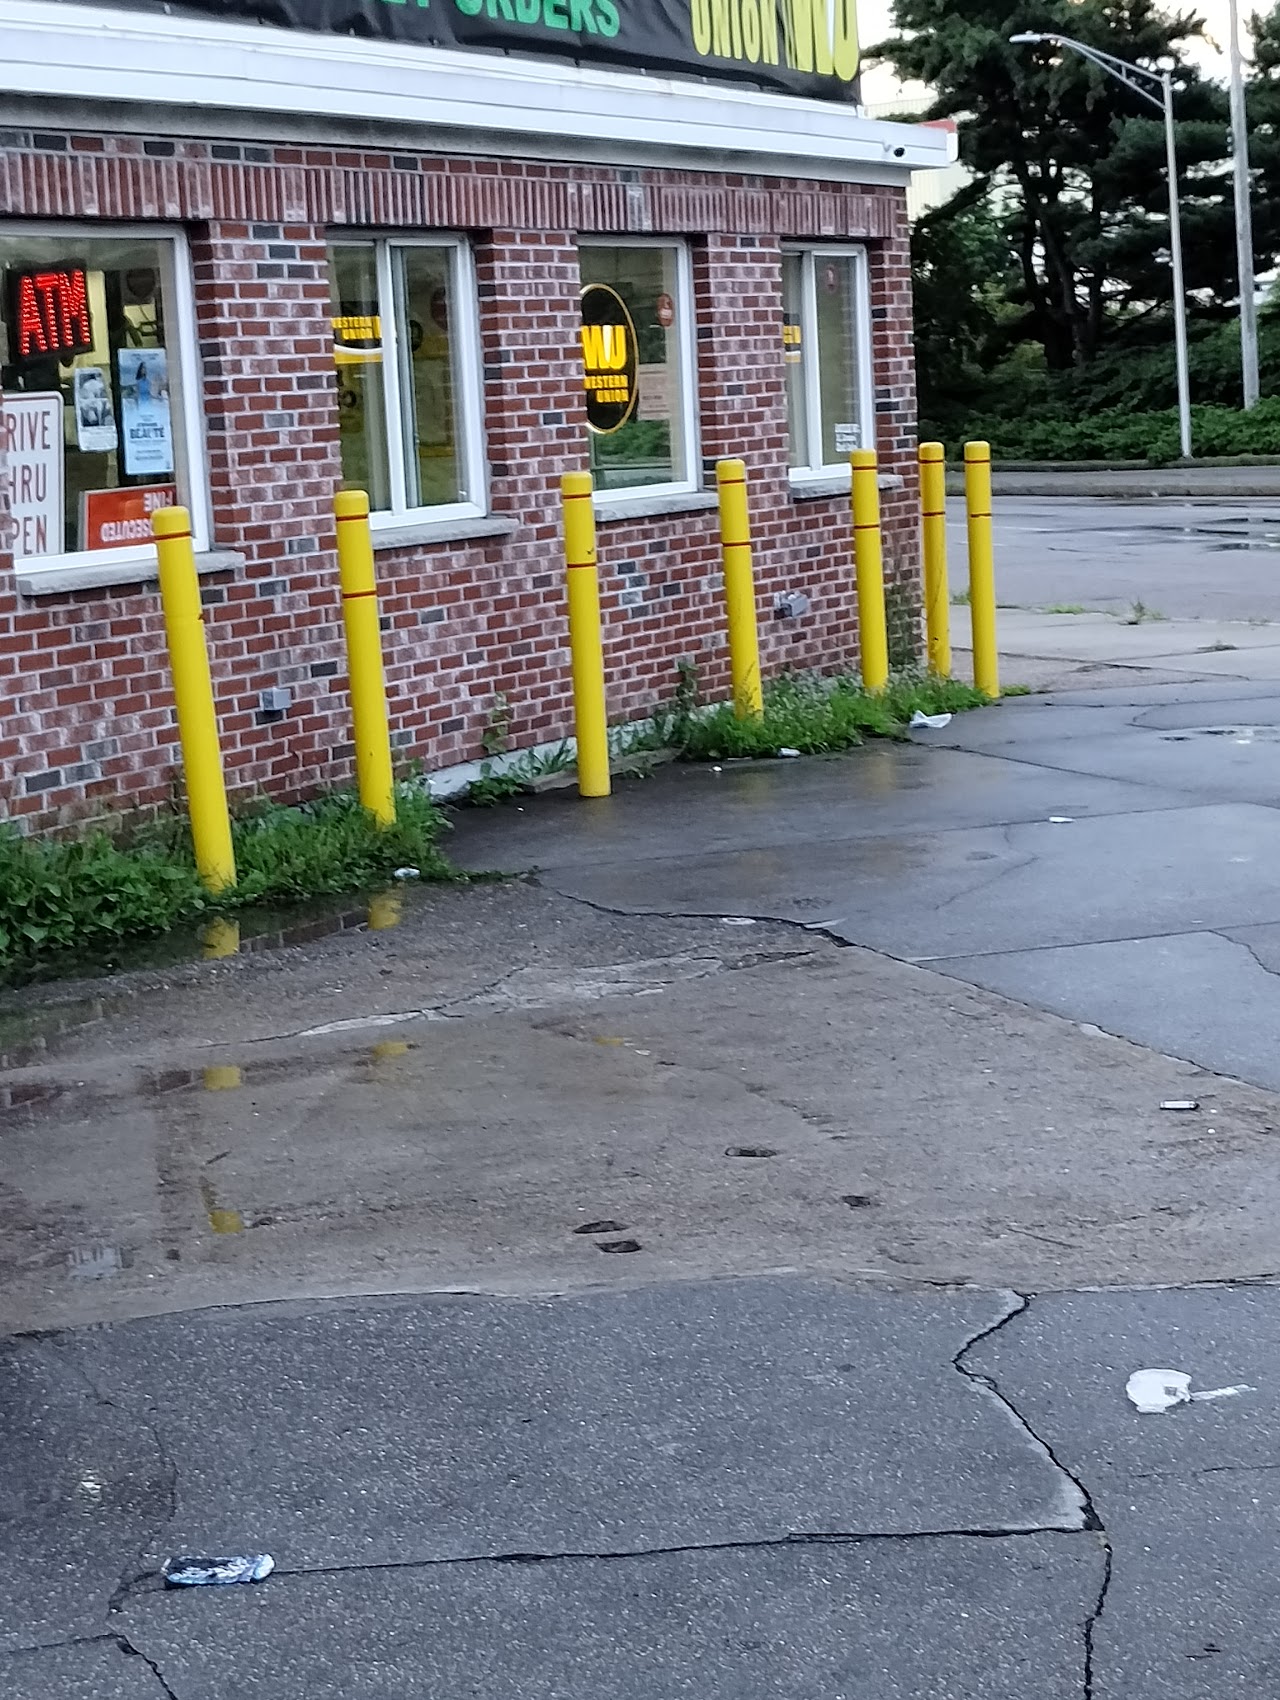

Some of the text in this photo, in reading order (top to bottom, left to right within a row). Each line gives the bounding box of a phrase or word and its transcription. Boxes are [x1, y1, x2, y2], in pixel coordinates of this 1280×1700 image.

[21, 269, 91, 355] ATM
[581, 325, 626, 370] WU
[596, 389, 629, 403] UNION
[7, 411, 51, 451] RIVE
[9, 463, 46, 504] HRU
[12, 514, 47, 555] PEN
[101, 518, 152, 542] SECUTED
